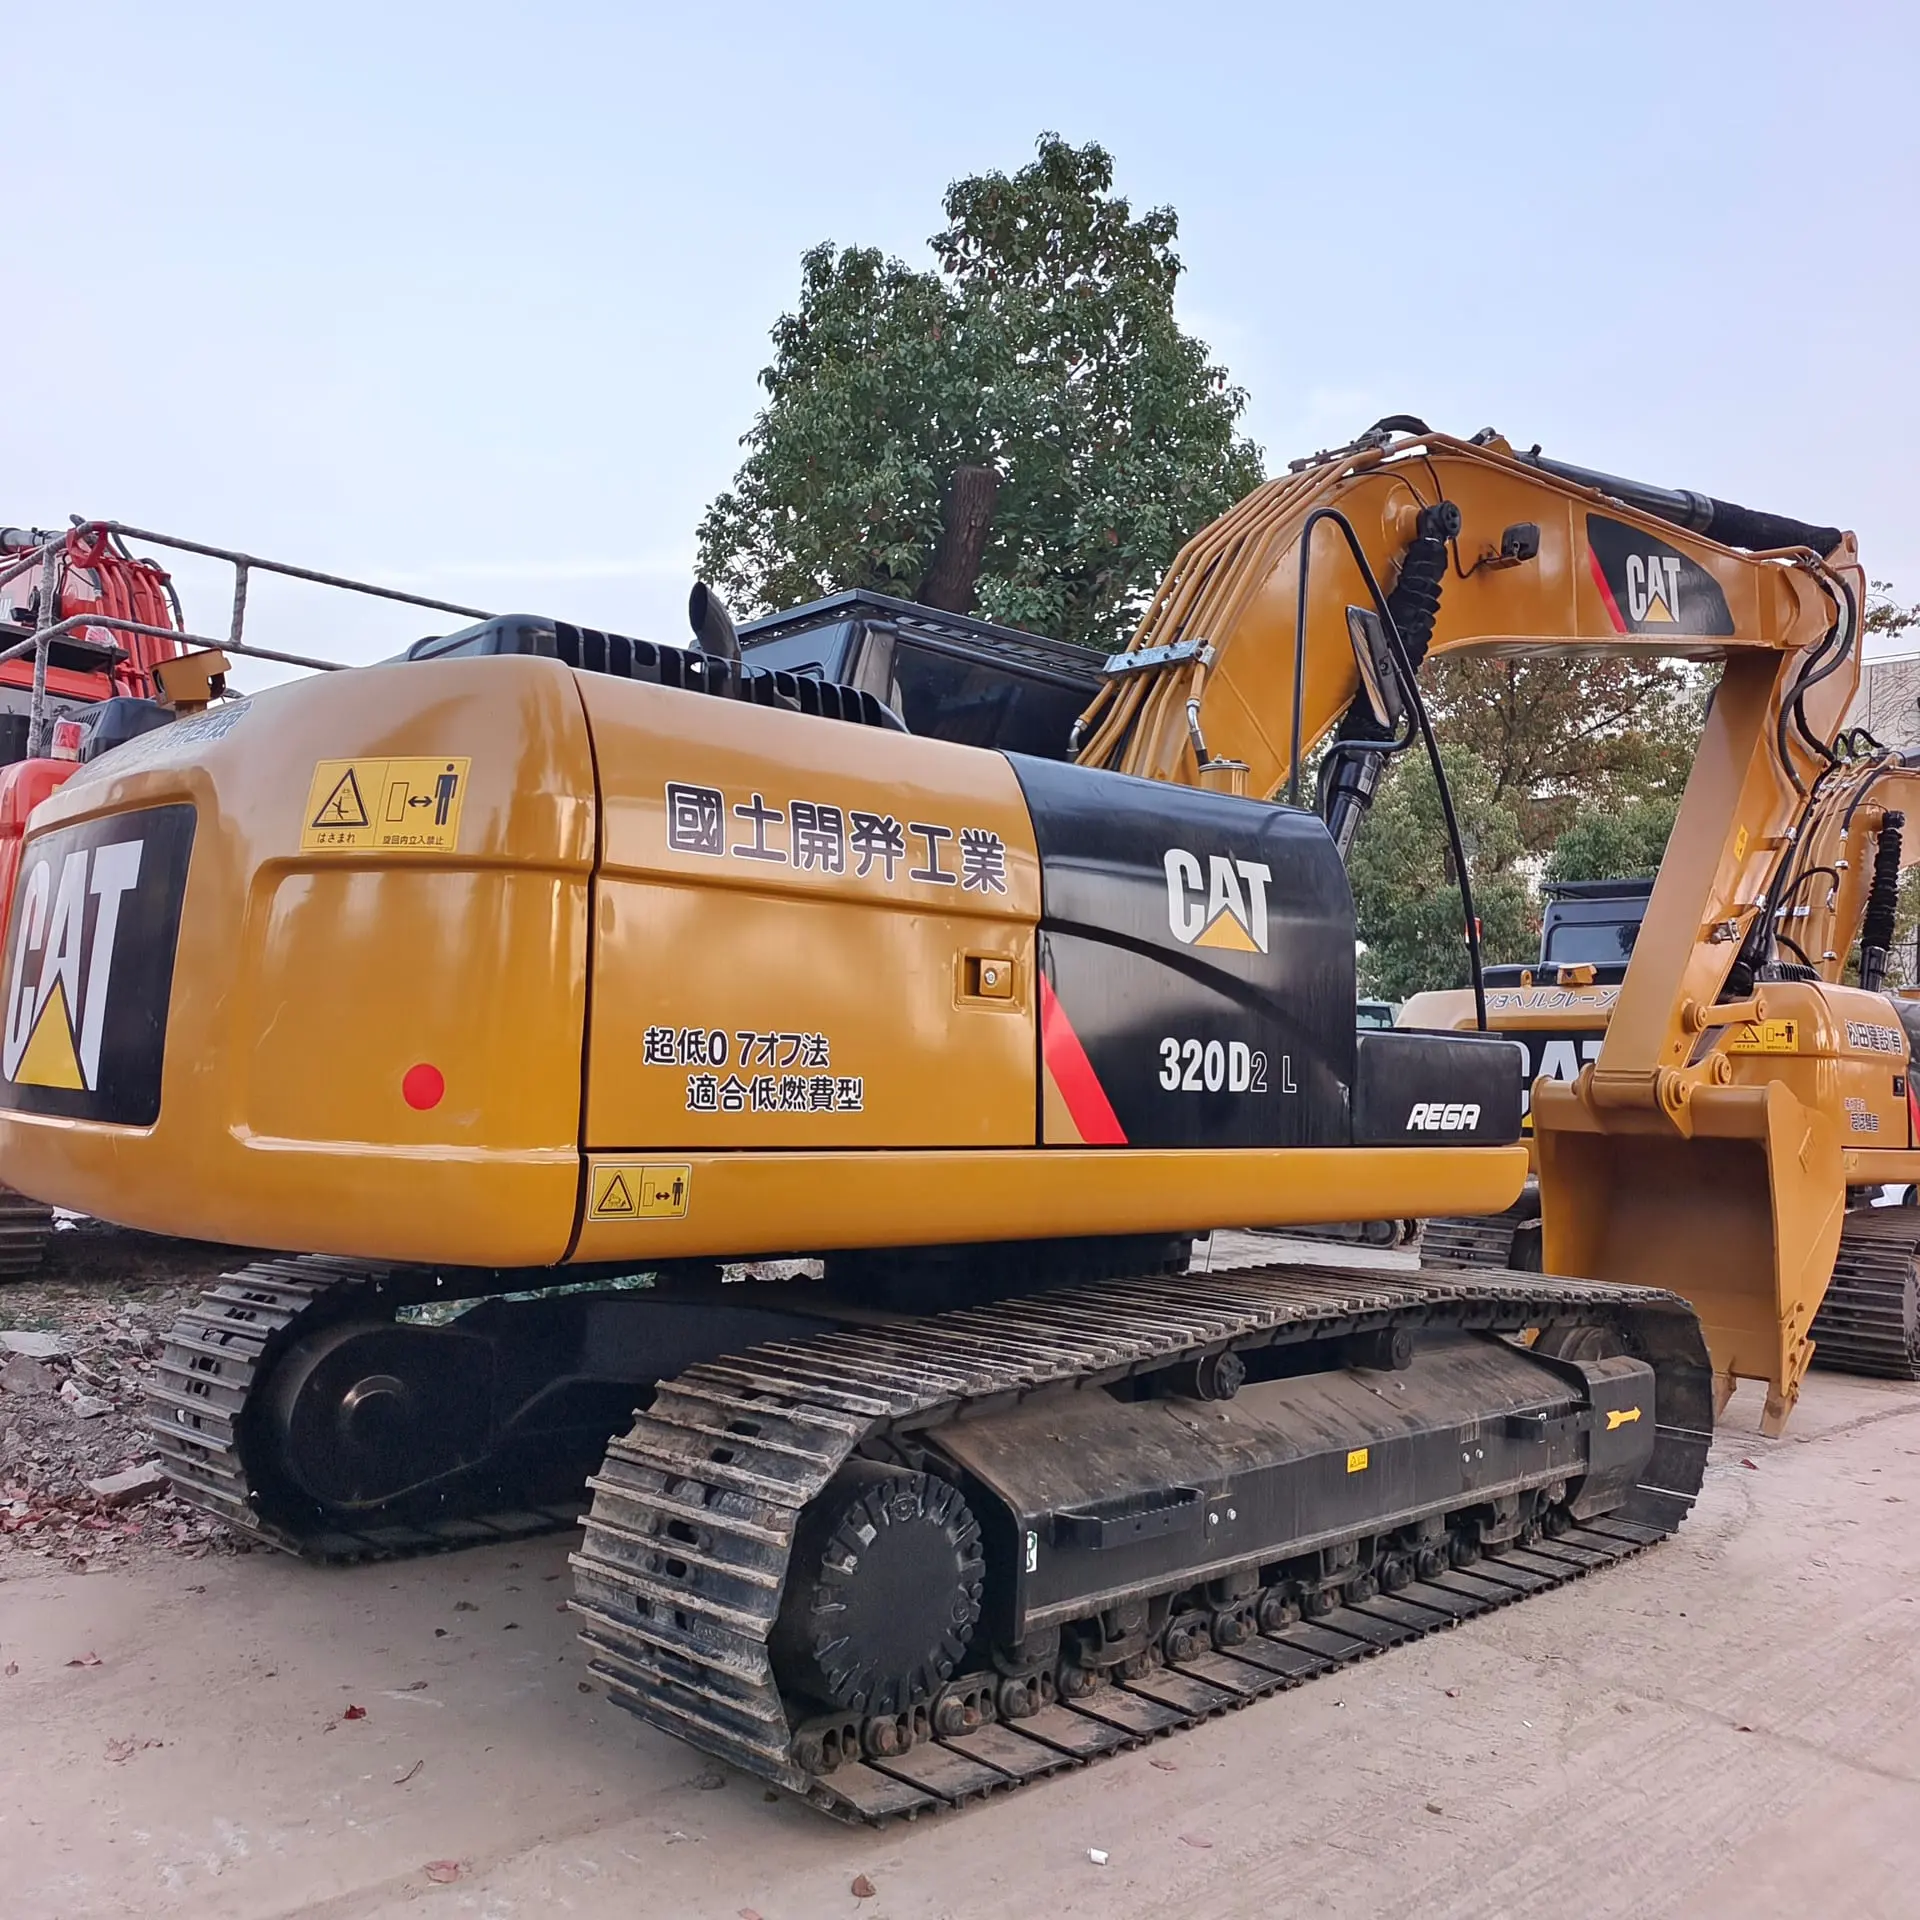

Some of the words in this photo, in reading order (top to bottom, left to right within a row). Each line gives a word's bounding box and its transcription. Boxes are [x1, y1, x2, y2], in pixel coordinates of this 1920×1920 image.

[1626, 554, 1680, 623] CAT
[316, 832, 356, 844] はさまれ
[665, 781, 1007, 895] 國土開発工業
[1164, 848, 1272, 954] CAT
[3, 839, 144, 1091] CAT
[685, 1073, 864, 1113] 適合低燃費型
[1159, 1037, 1268, 1092] 320D2
[1282, 1055, 1297, 1093] L
[1406, 1103, 1480, 1130] REGA
